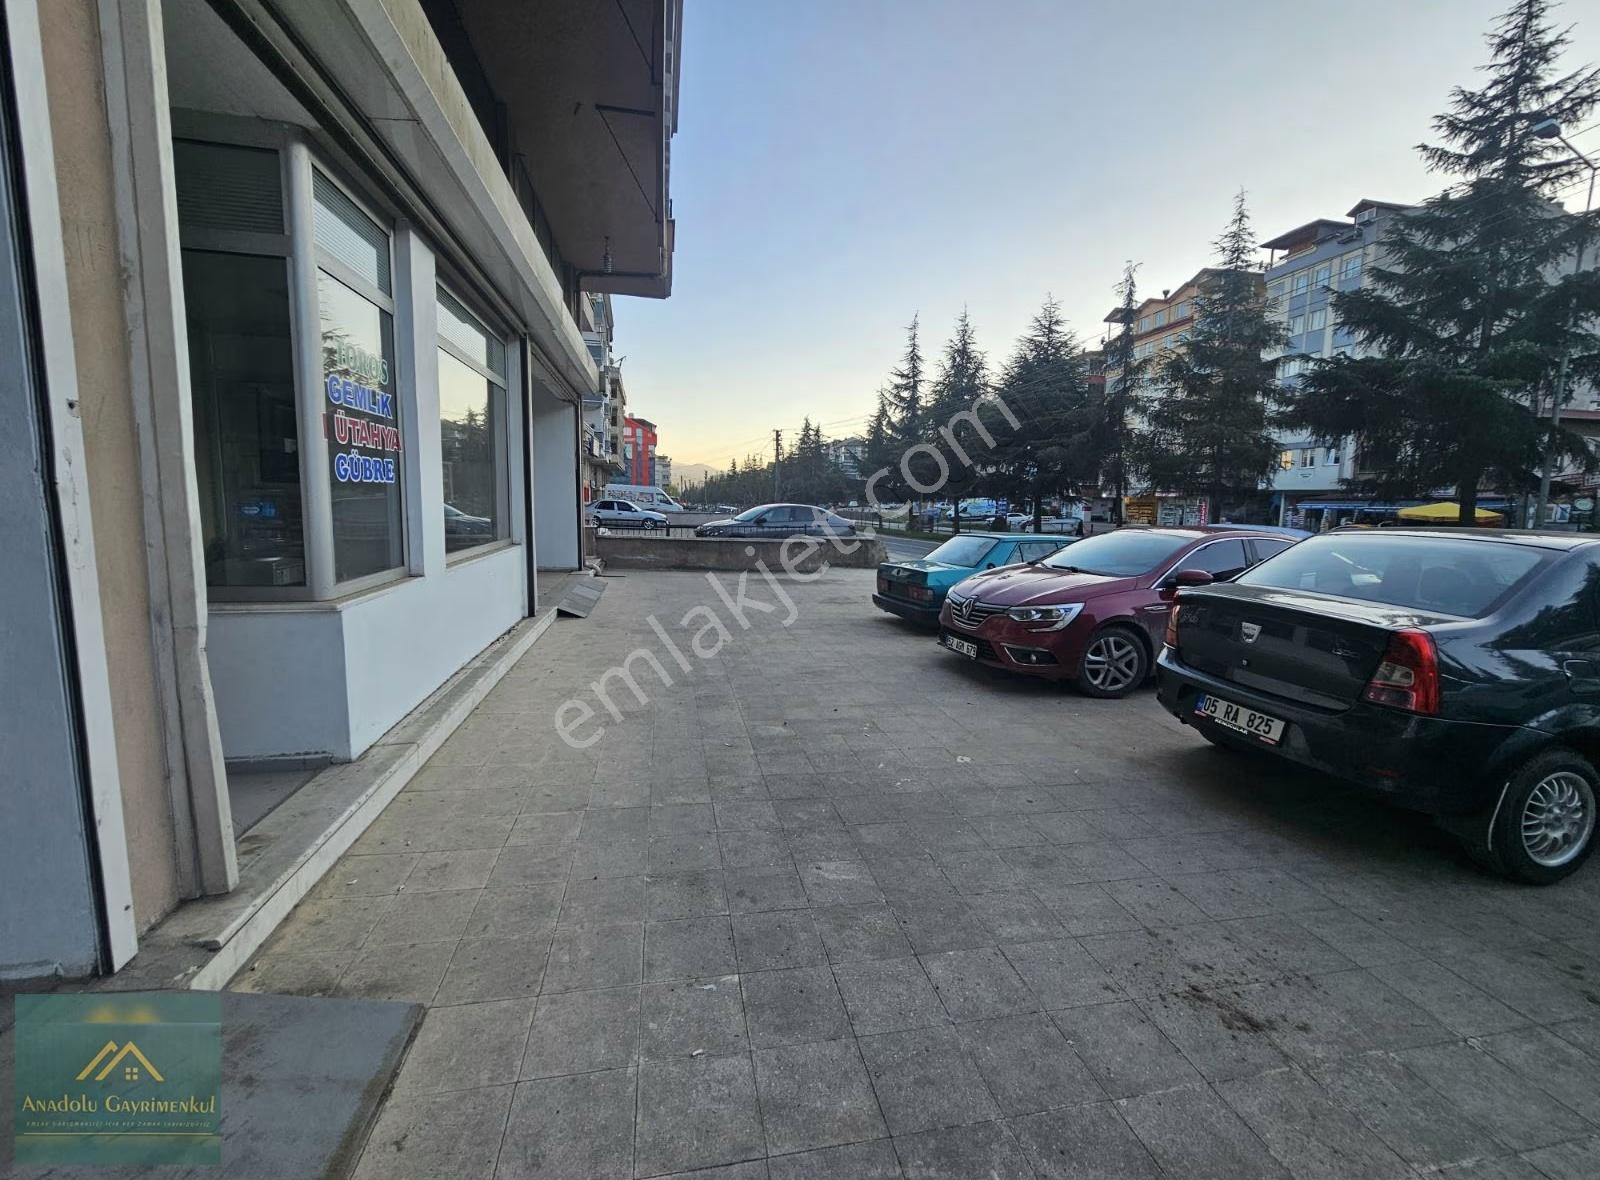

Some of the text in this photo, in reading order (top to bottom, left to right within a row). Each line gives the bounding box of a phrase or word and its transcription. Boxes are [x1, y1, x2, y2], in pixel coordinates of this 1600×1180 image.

[323, 409, 402, 452] ÜTAHYA
[334, 450, 395, 483] GÜBRE
[1203, 697, 1219, 714] 05
[1223, 704, 1240, 723] RA
[1246, 713, 1274, 735] 825
